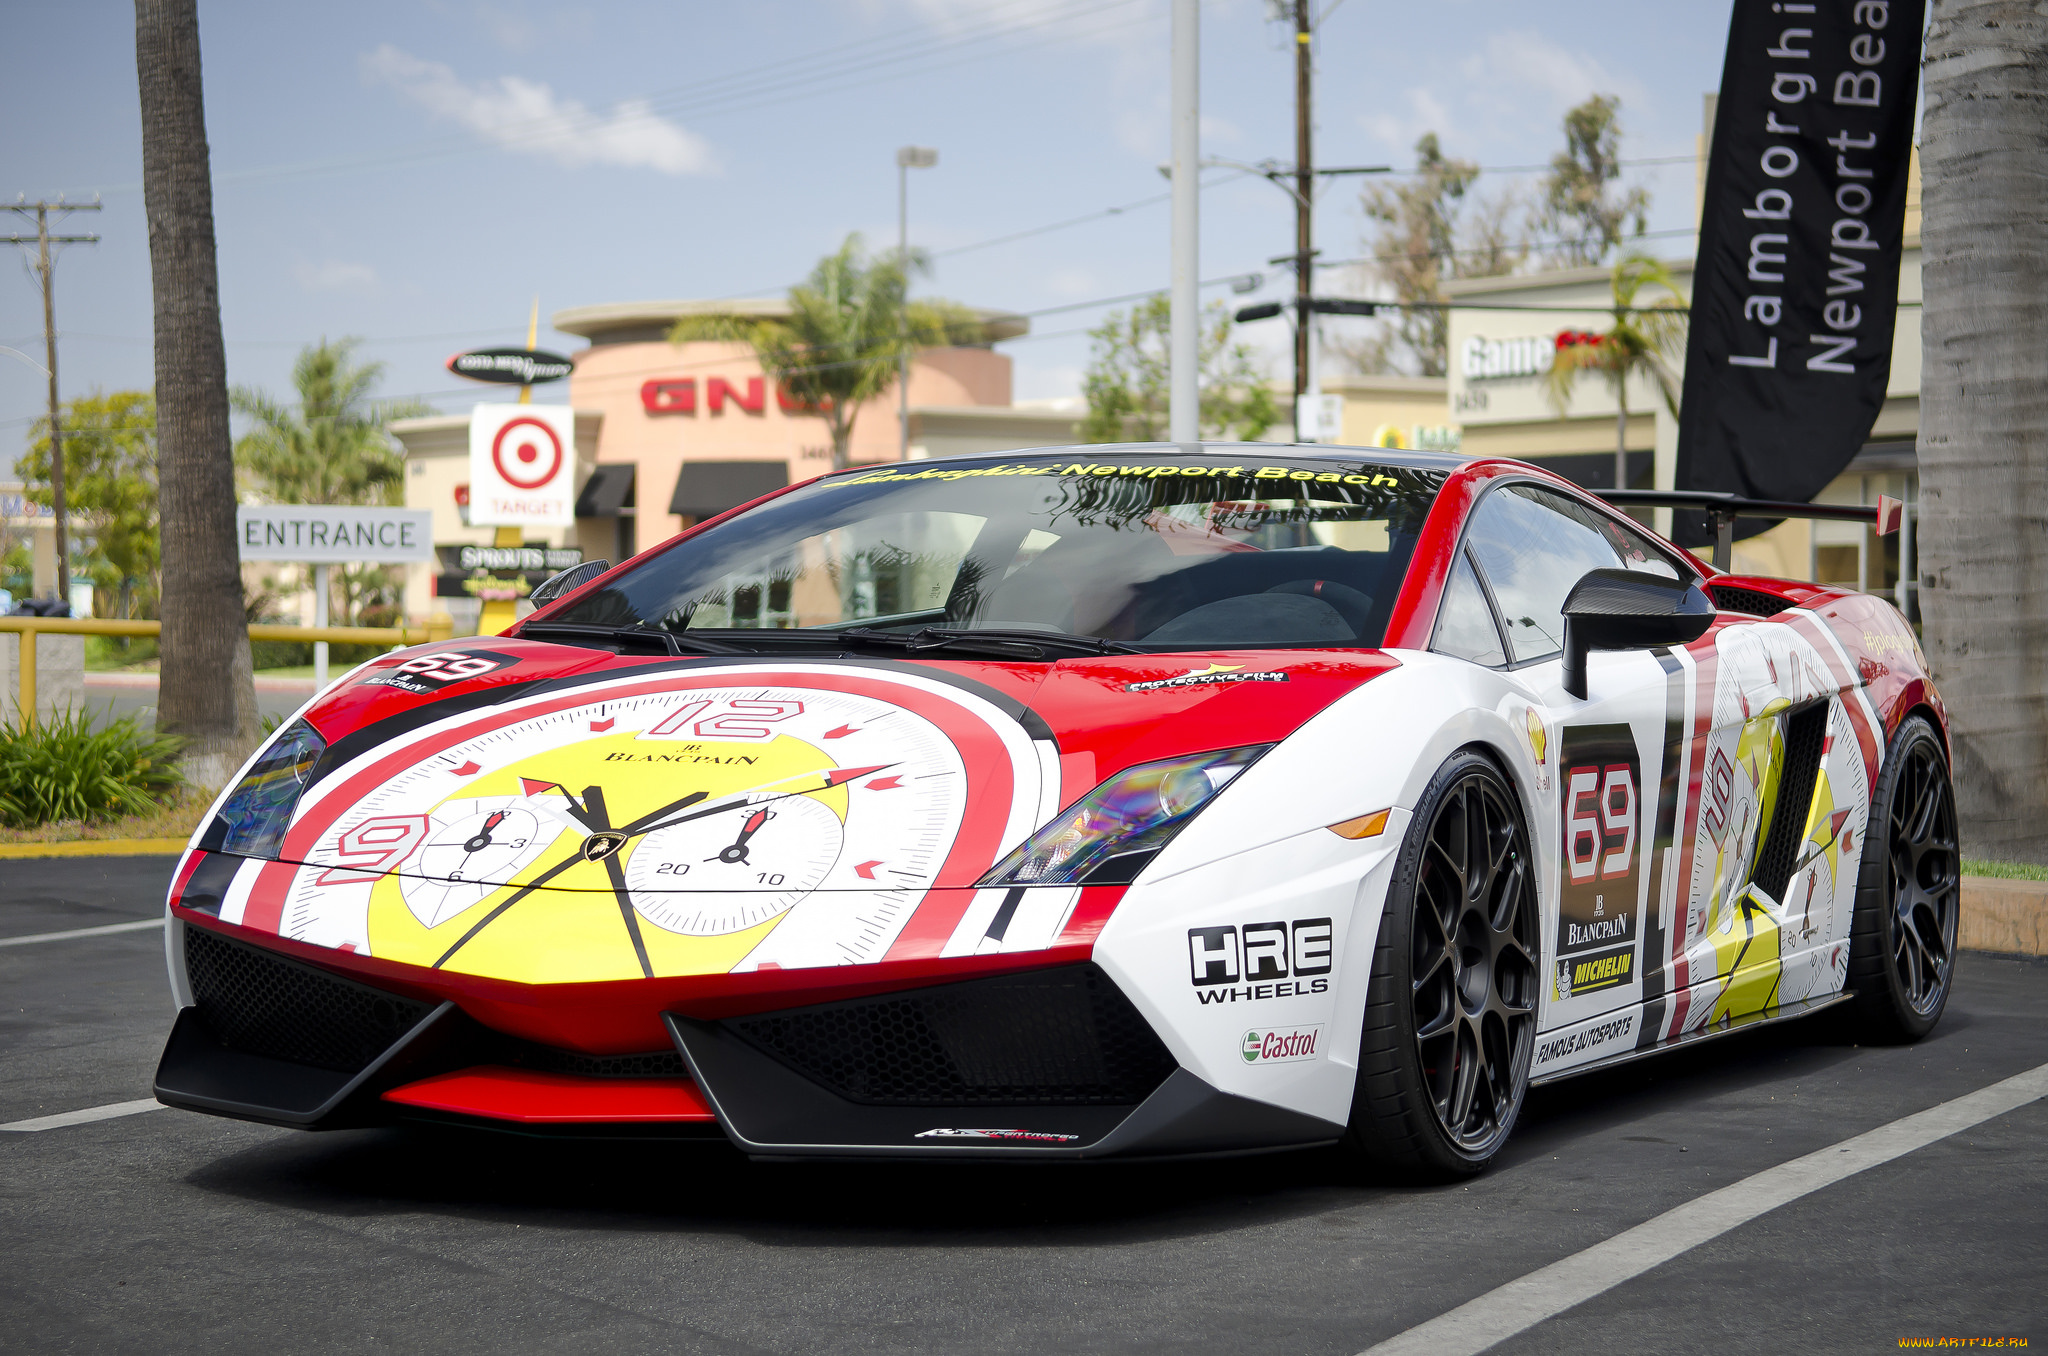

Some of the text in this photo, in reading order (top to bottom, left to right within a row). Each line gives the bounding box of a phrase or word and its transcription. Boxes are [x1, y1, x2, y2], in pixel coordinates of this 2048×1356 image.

[1728, 2, 1817, 368] Lamborghi
[1806, 130, 1880, 373] Newport
[821, 463, 1399, 488] Lamborghini Newport Beach
[492, 499, 563, 515] TARGET
[245, 519, 417, 548] ENTRANCE
[461, 547, 544, 570] SPROUTS
[394, 652, 501, 682] 69
[1129, 674, 1238, 692] PROTECTIVE
[1243, 672, 1284, 683] FILM
[648, 699, 805, 738] 12
[604, 752, 760, 766] BLANCPAIN
[1565, 762, 1638, 886] 69
[315, 813, 430, 886] 9
[510, 838, 527, 849] 3
[656, 862, 691, 876] 20
[756, 872, 786, 886] 10
[1567, 912, 1628, 946] BLANCPAIN
[1188, 917, 1333, 987] HRE
[1573, 953, 1632, 985] MICHELIN
[1196, 978, 1329, 1005] WHEELS
[1262, 1028, 1318, 1060] Castrol
[1536, 1015, 1634, 1065] FAMOUS AUTOSPORTS
